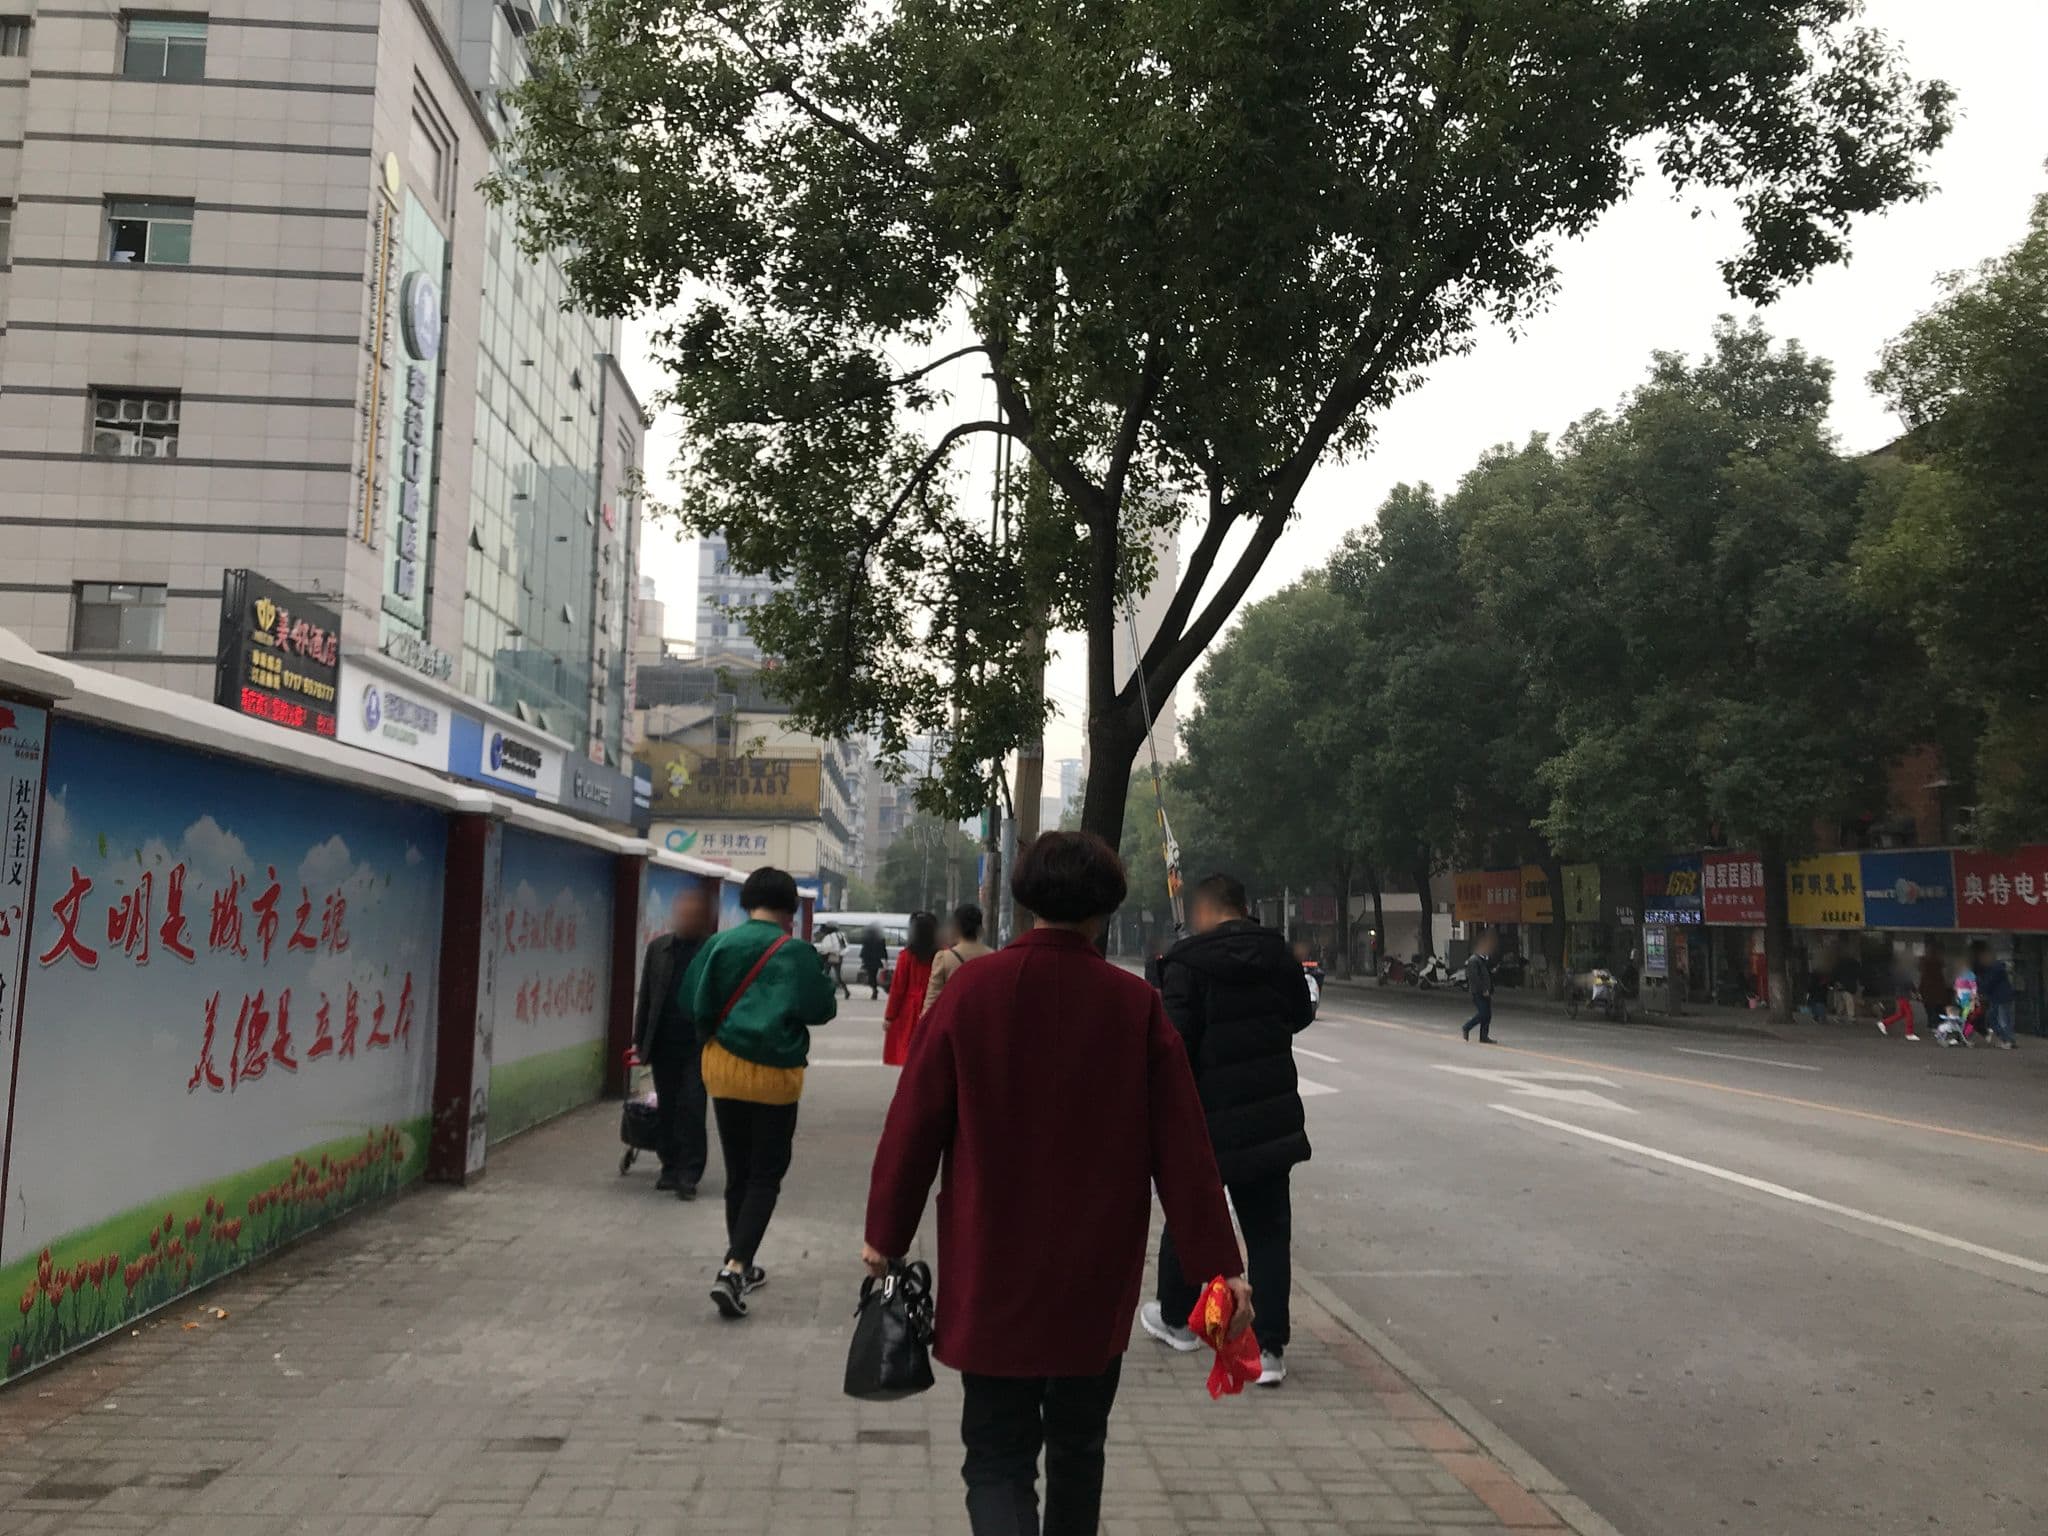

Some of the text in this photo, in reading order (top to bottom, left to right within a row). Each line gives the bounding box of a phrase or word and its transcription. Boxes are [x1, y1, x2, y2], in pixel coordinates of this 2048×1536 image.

[698, 778, 790, 795] GYMBABY
[8, 780, 31, 886] 社会主义
[41, 863, 350, 968] 文明是城市之魂
[1666, 871, 1697, 895] 1573
[1962, 872, 2048, 905] 奥特电
[188, 971, 415, 1092] 美德是立身之本
